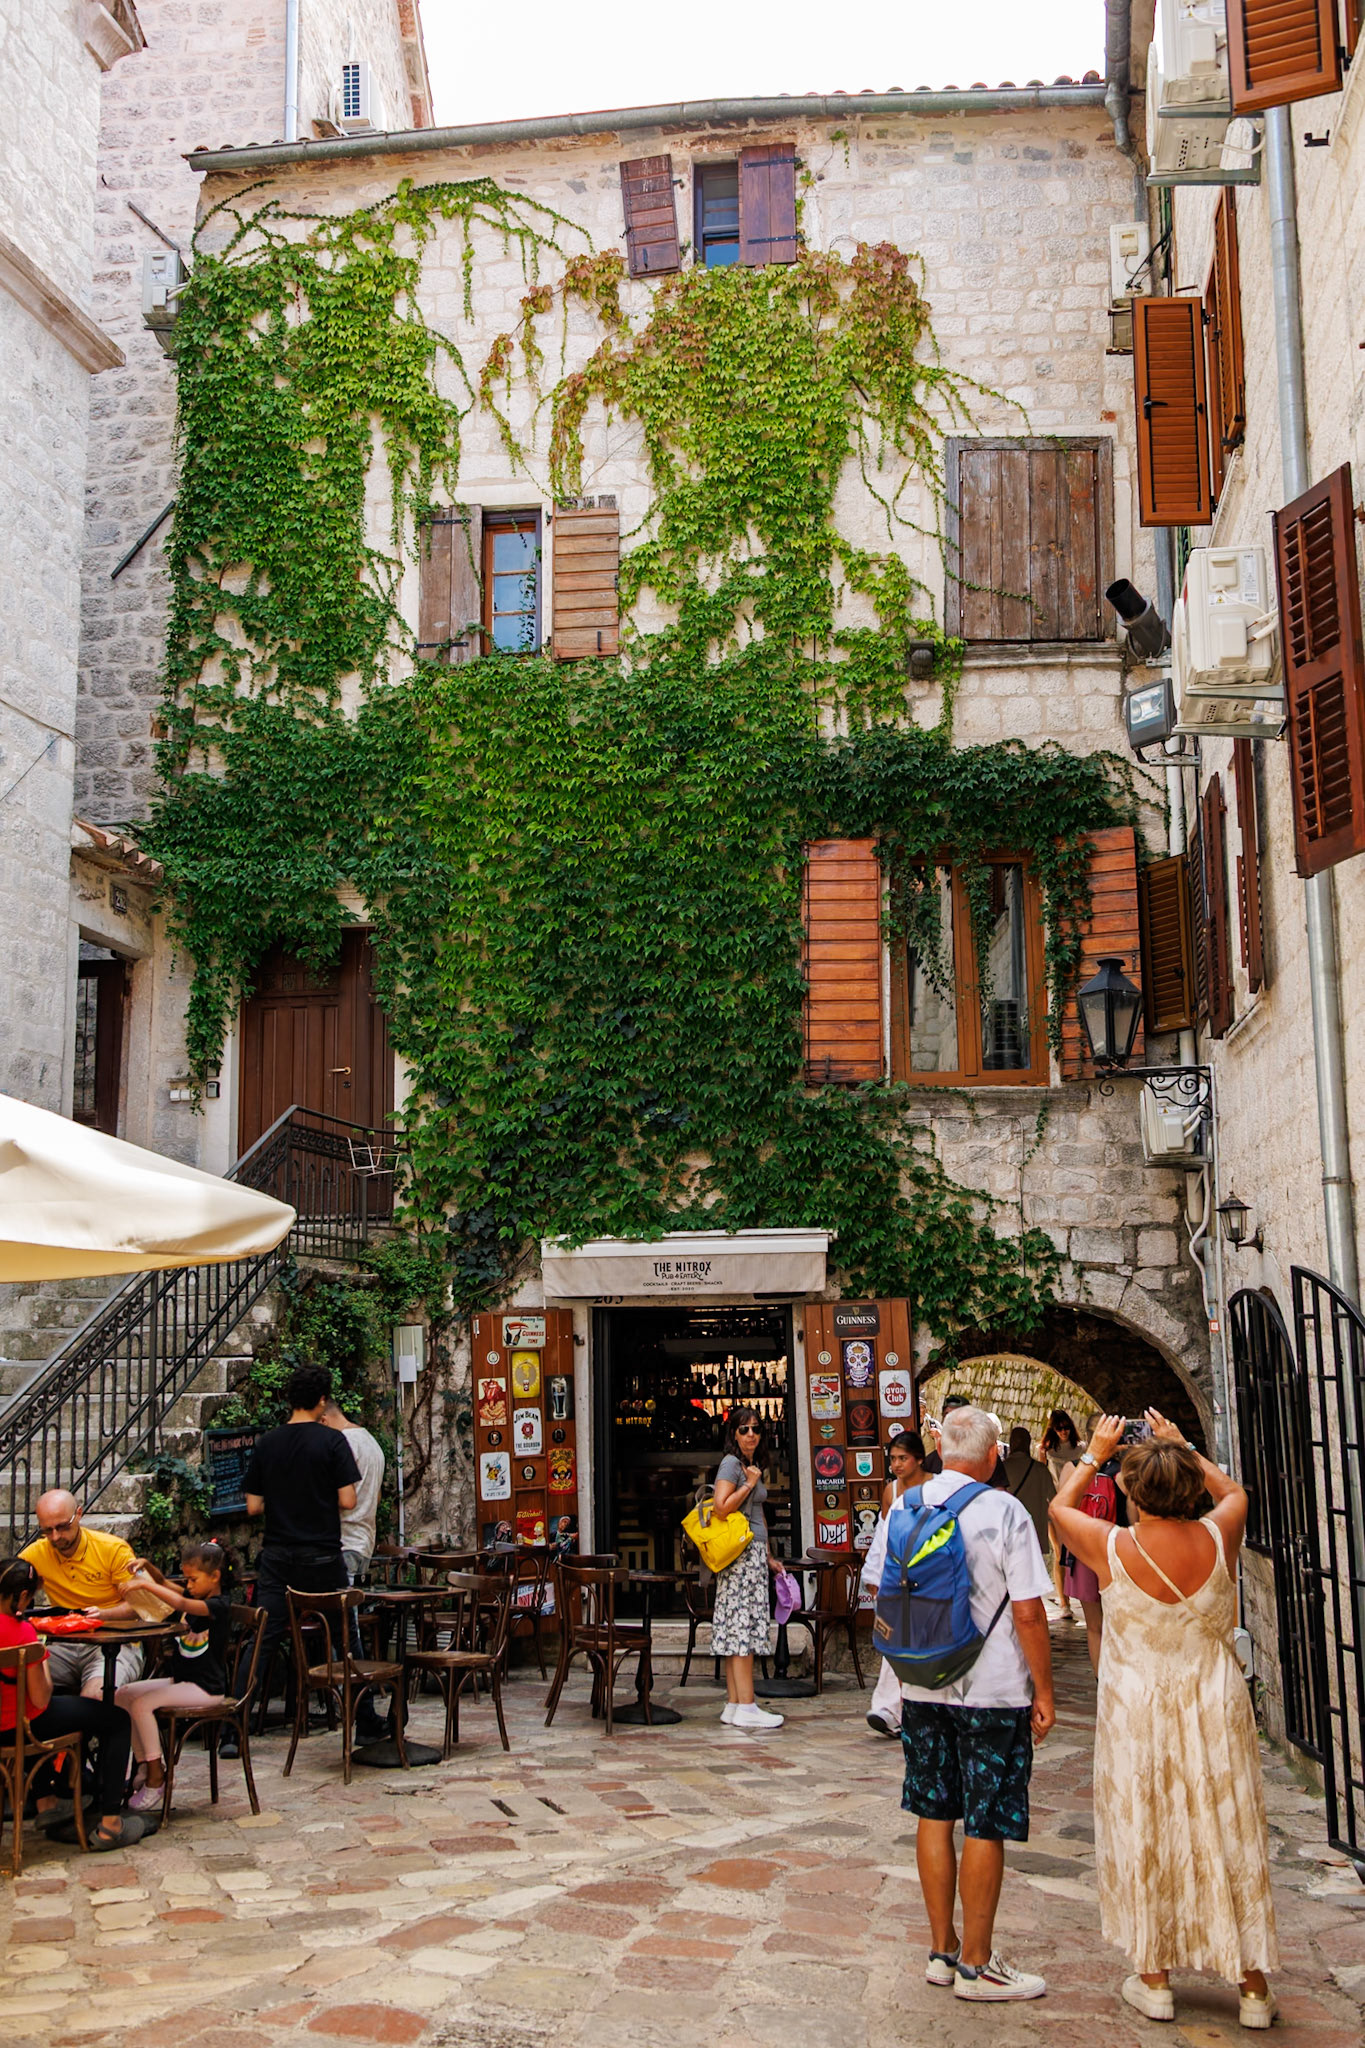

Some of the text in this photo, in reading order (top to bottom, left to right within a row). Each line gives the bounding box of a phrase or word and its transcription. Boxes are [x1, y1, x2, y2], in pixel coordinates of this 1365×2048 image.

[653, 1261, 711, 1277] THE NITROX
[836, 1315, 876, 1325] GUINNESS
[887, 1394, 904, 1402] Club
[525, 1411, 539, 1422] BEAM
